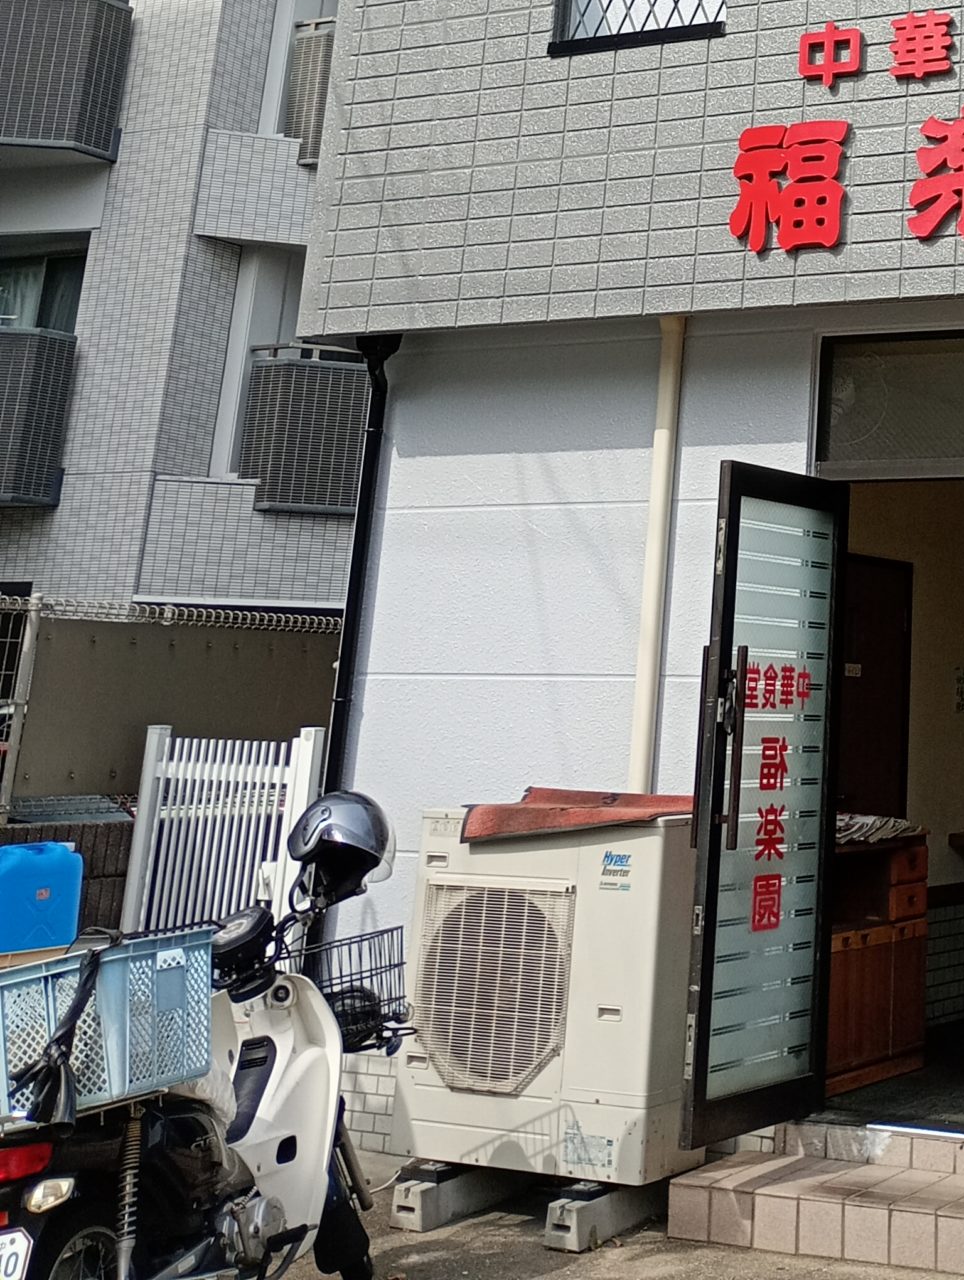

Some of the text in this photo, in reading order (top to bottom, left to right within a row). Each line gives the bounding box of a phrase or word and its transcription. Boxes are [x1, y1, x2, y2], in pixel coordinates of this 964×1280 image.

[602, 850, 632, 866] Hyper
[601, 865, 631, 877] Inverter
[0, 1251, 20, 1278] 0
